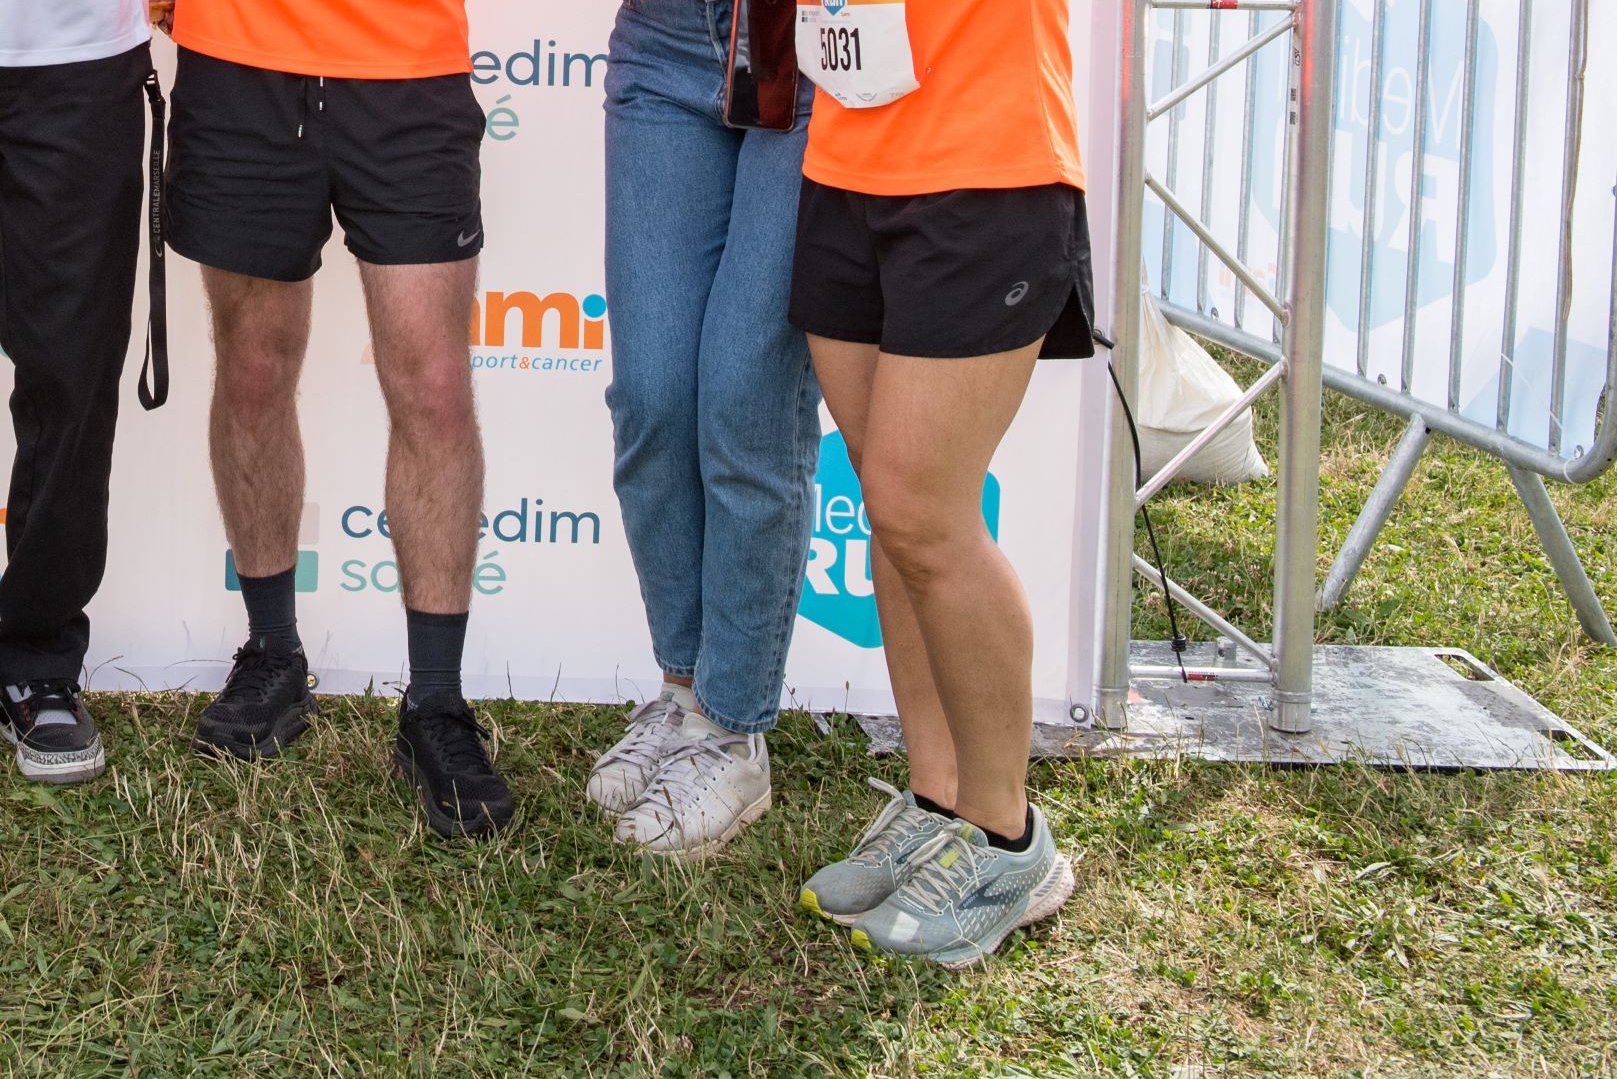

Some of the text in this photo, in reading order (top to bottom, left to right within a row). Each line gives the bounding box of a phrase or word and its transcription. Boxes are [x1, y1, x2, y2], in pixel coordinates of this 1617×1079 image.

[820, 27, 862, 71] 5031
[470, 354, 603, 372] port&cancer
[340, 550, 507, 595] saé
